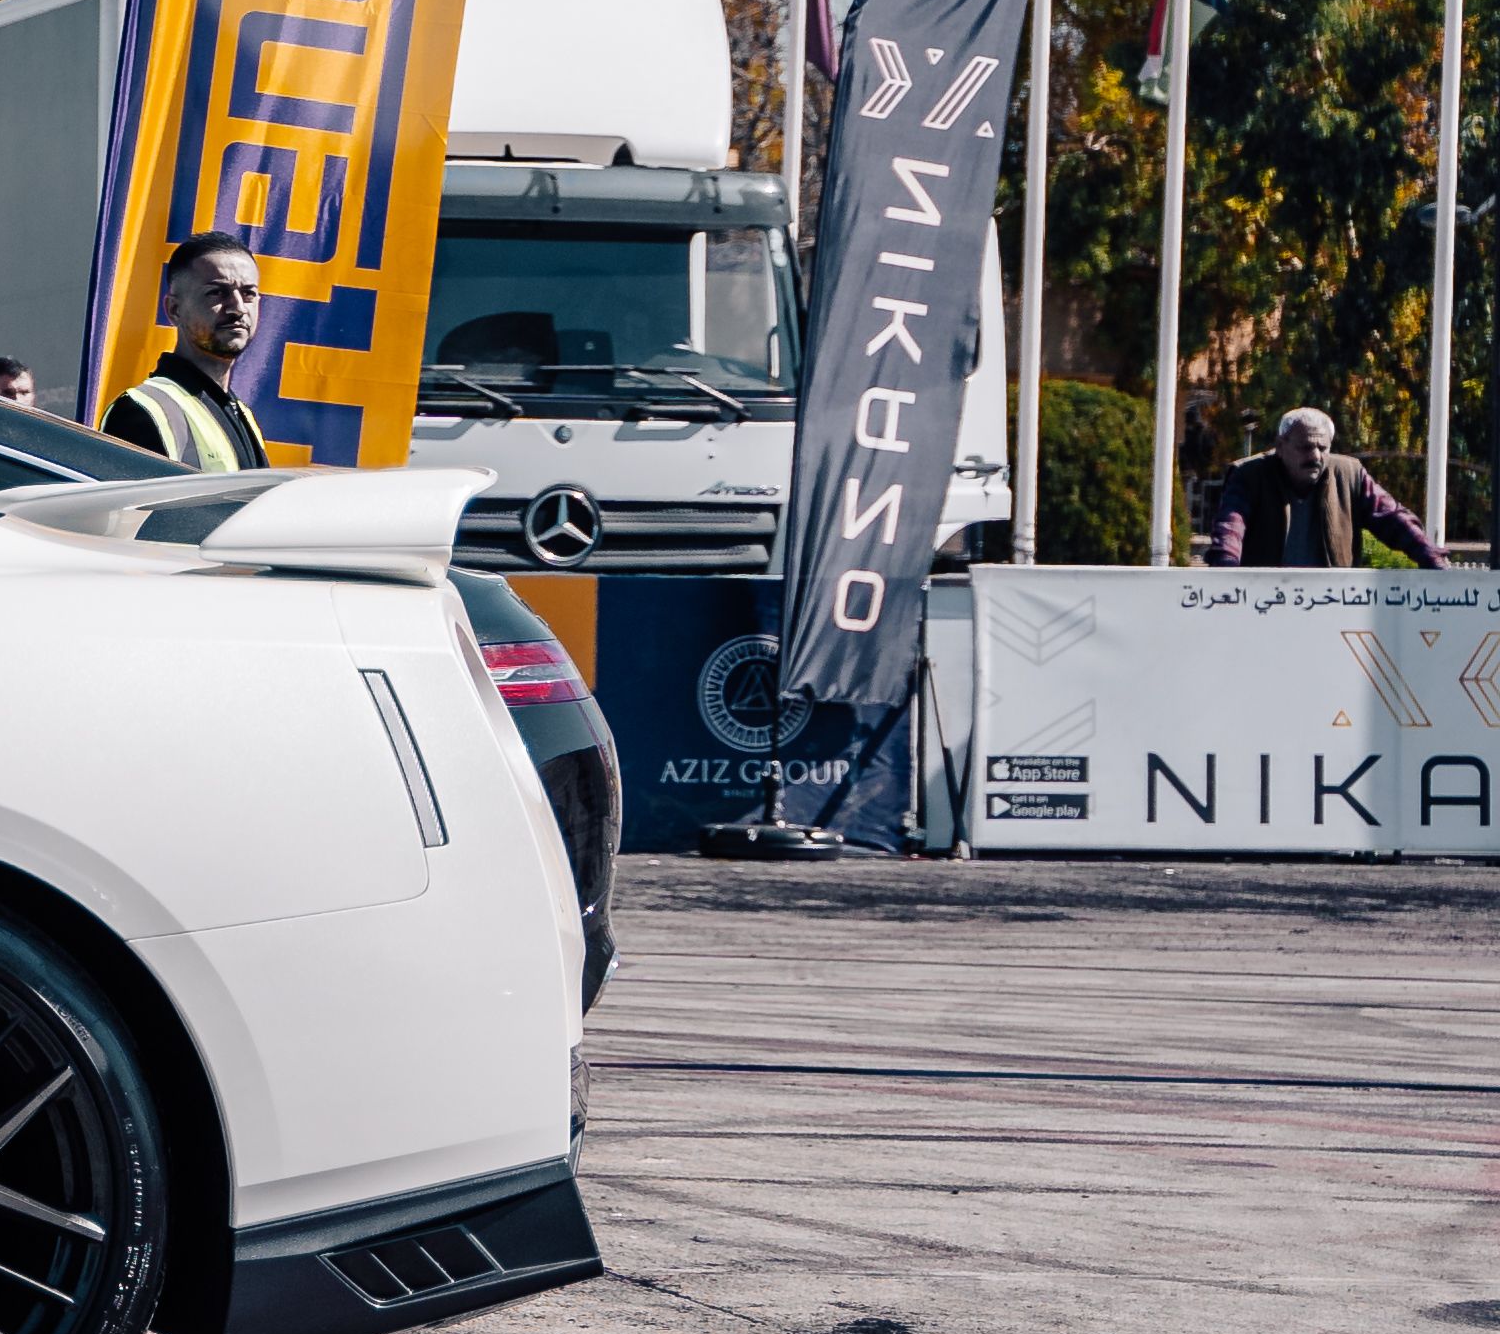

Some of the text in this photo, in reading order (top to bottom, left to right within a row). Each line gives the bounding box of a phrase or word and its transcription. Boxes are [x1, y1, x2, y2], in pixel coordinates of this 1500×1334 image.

[1180, 584, 1248, 609] العراق
[1254, 585, 1287, 614] في
[1293, 586, 1379, 611] الفاخرة
[1384, 584, 1480, 613] للسيارات
[658, 758, 731, 784] AZIZ
[1011, 765, 1081, 782] App Store
[1146, 751, 1491, 827] NIKA
[1011, 803, 1081, 820] Google play
